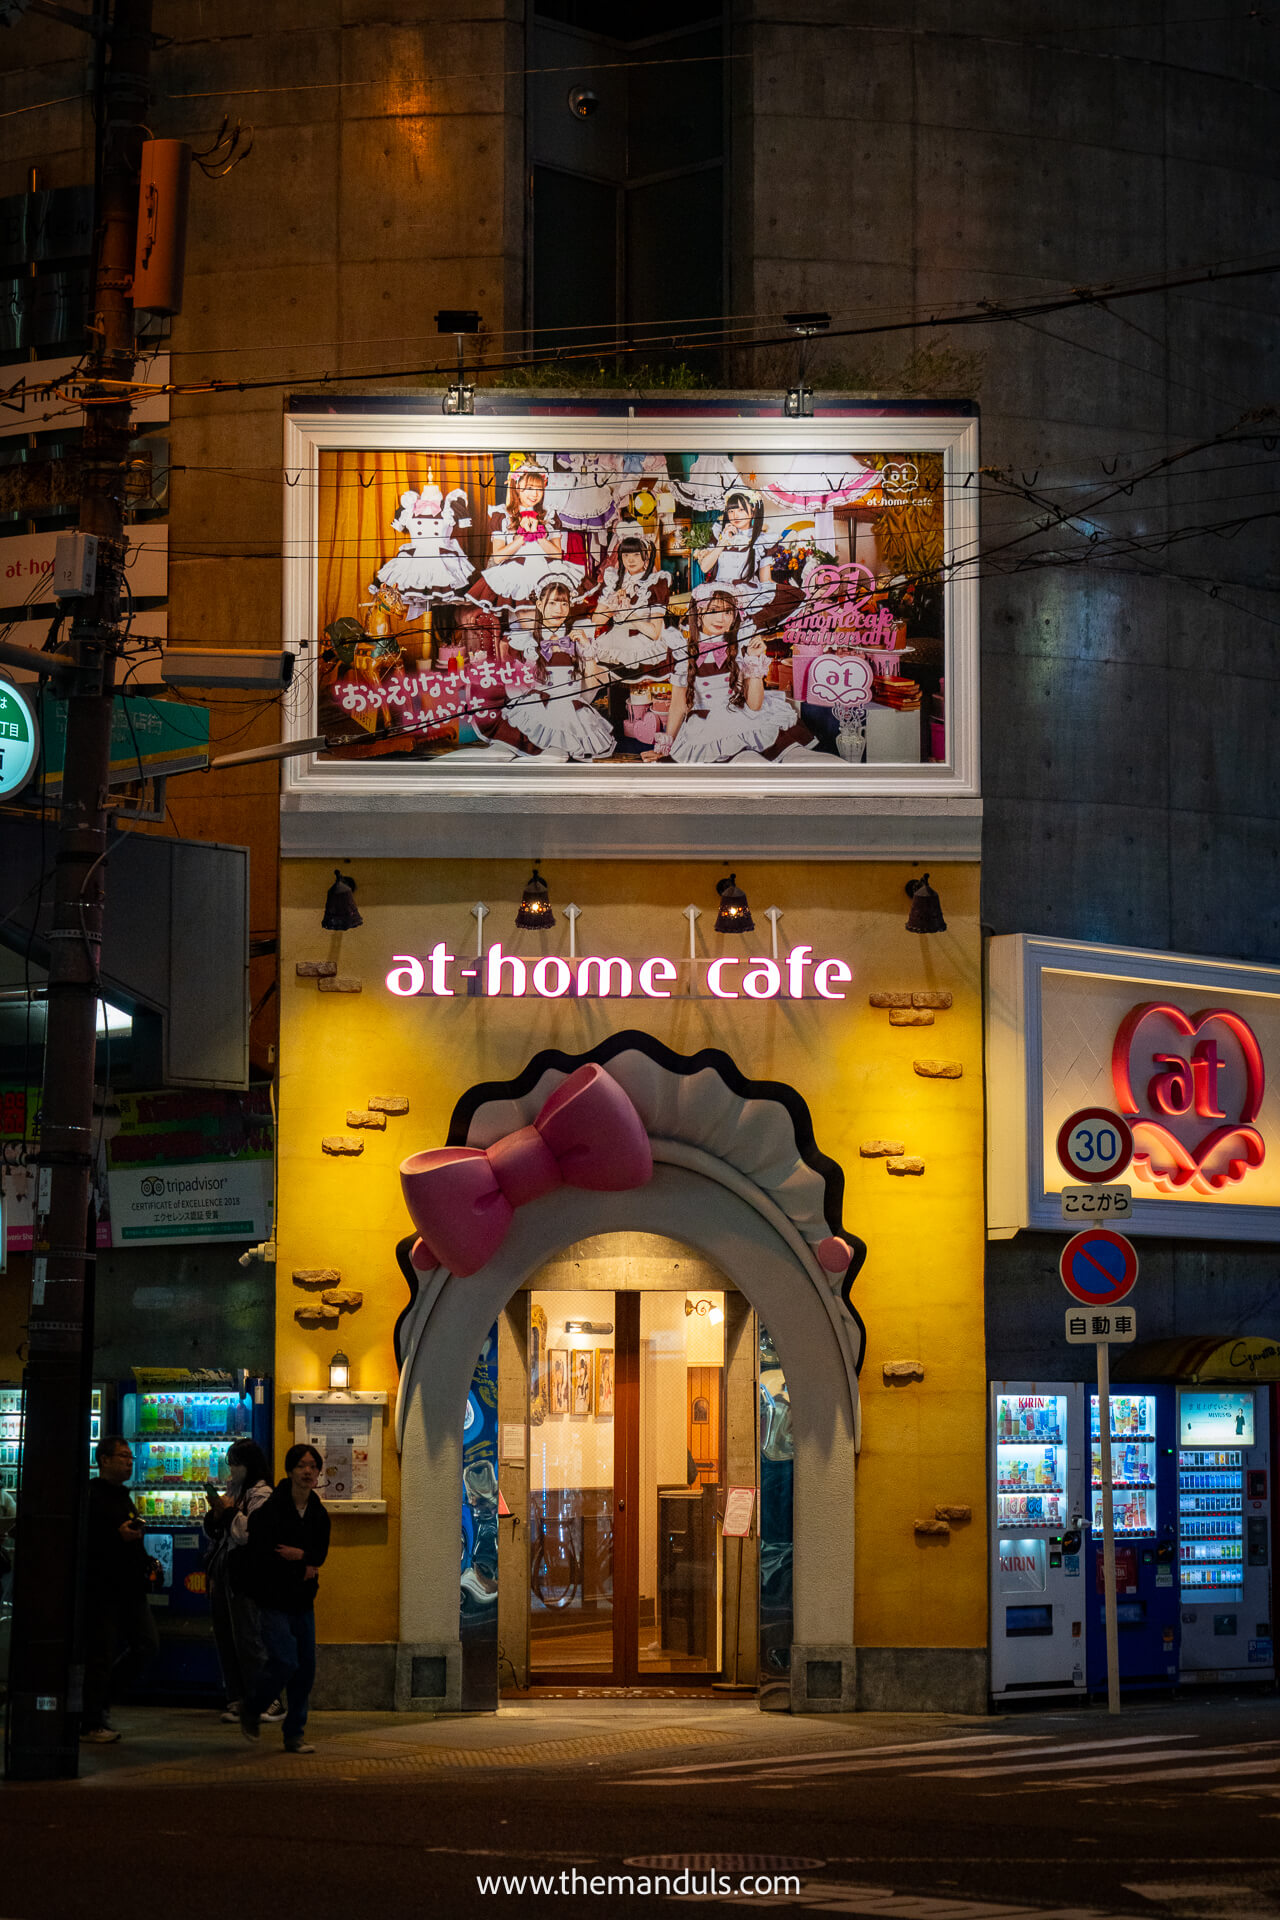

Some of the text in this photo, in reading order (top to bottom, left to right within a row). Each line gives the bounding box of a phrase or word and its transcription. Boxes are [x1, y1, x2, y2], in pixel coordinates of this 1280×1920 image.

[890, 467, 909, 482] at
[866, 497, 909, 507] at-home
[782, 629, 898, 651] anniversary
[335, 661, 534, 711] 「おかえりなさいませ」を
[826, 668, 853, 687] at
[385, 941, 853, 999] at-home cafe
[1147, 1039, 1226, 1119] at
[1075, 1130, 1116, 1163] 30
[167, 1176, 224, 1195] tripadvisor
[131, 1200, 172, 1211] CERTIFICATE
[173, 1199, 181, 1209] of
[181, 1198, 223, 1208] EXCELLENCE
[1065, 1193, 1129, 1212] ここから
[1070, 1316, 1133, 1336] 自動車
[1018, 1397, 1045, 1409] KIRIN
[1000, 1556, 1035, 1572] KIRIN
